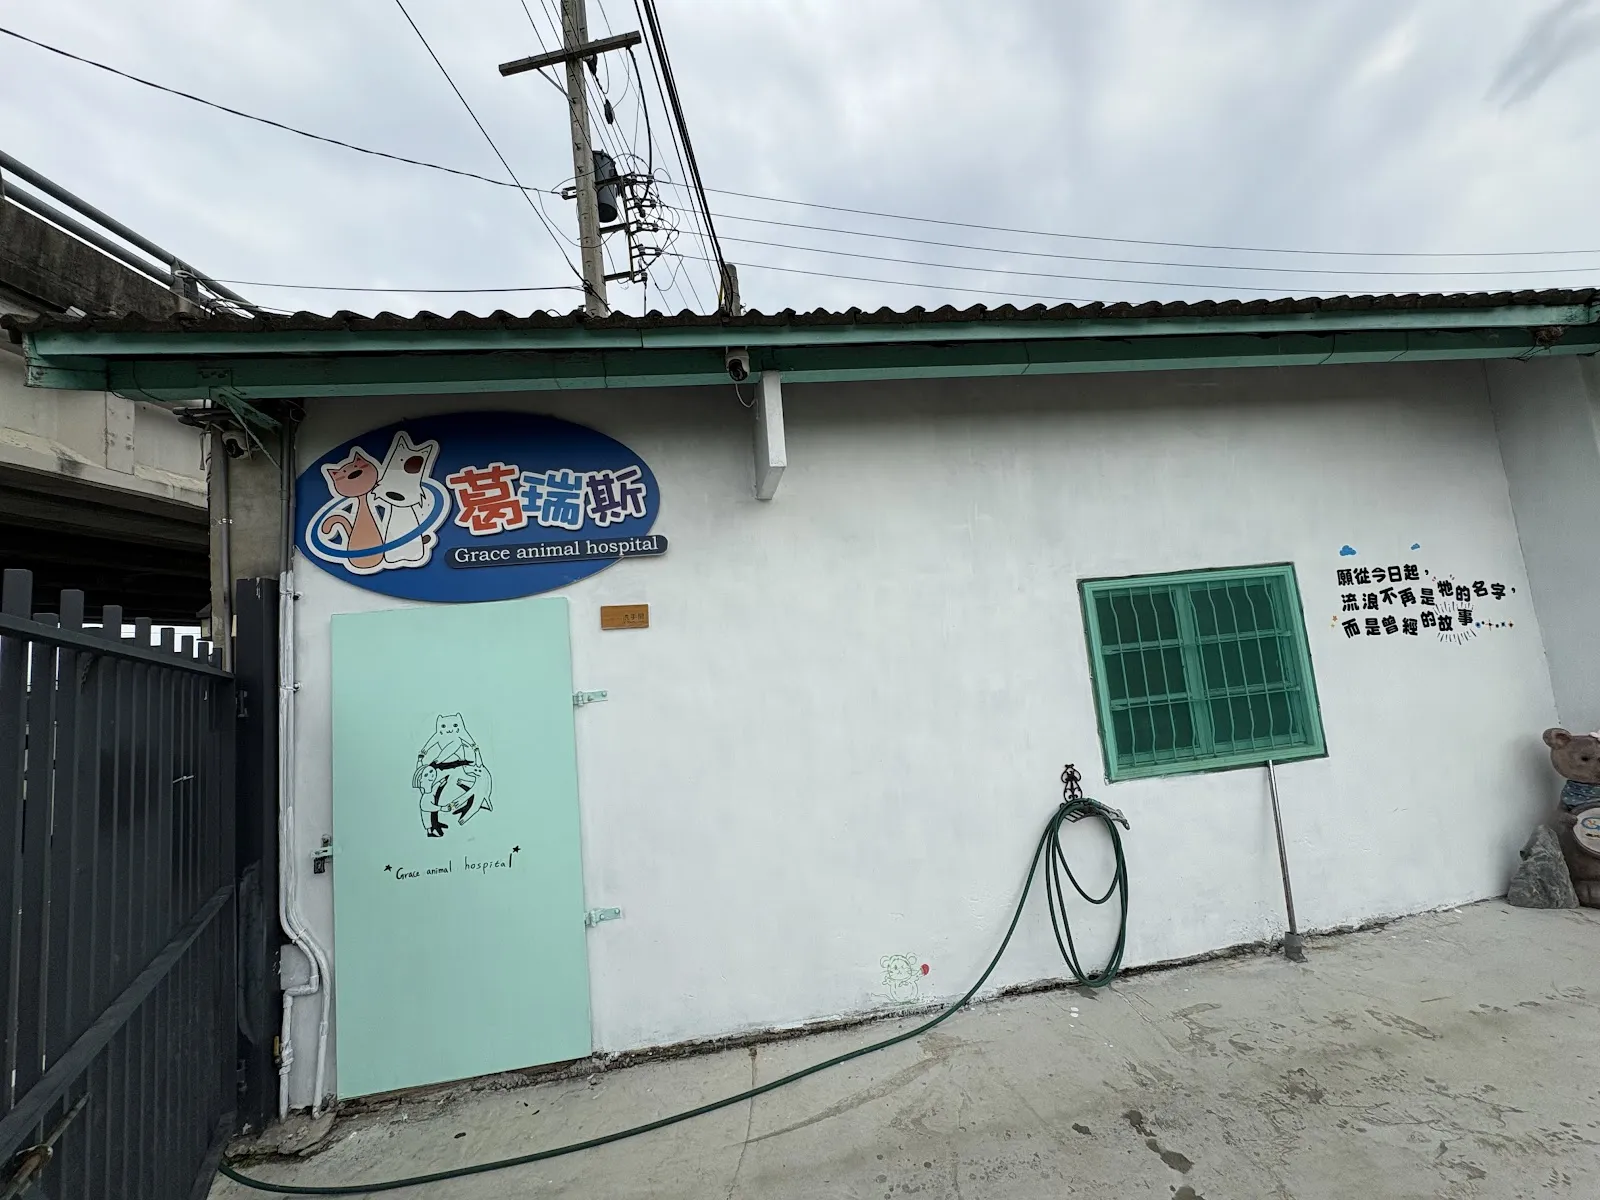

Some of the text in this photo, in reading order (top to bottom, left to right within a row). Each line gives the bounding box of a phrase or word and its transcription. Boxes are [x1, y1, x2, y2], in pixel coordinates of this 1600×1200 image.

[447, 463, 647, 533] 葛瑞斯
[454, 537, 660, 563] Grace animal hospital
[1341, 608, 1474, 639] 而是曾經的故事
[395, 853, 513, 880] Grace animal hospital
